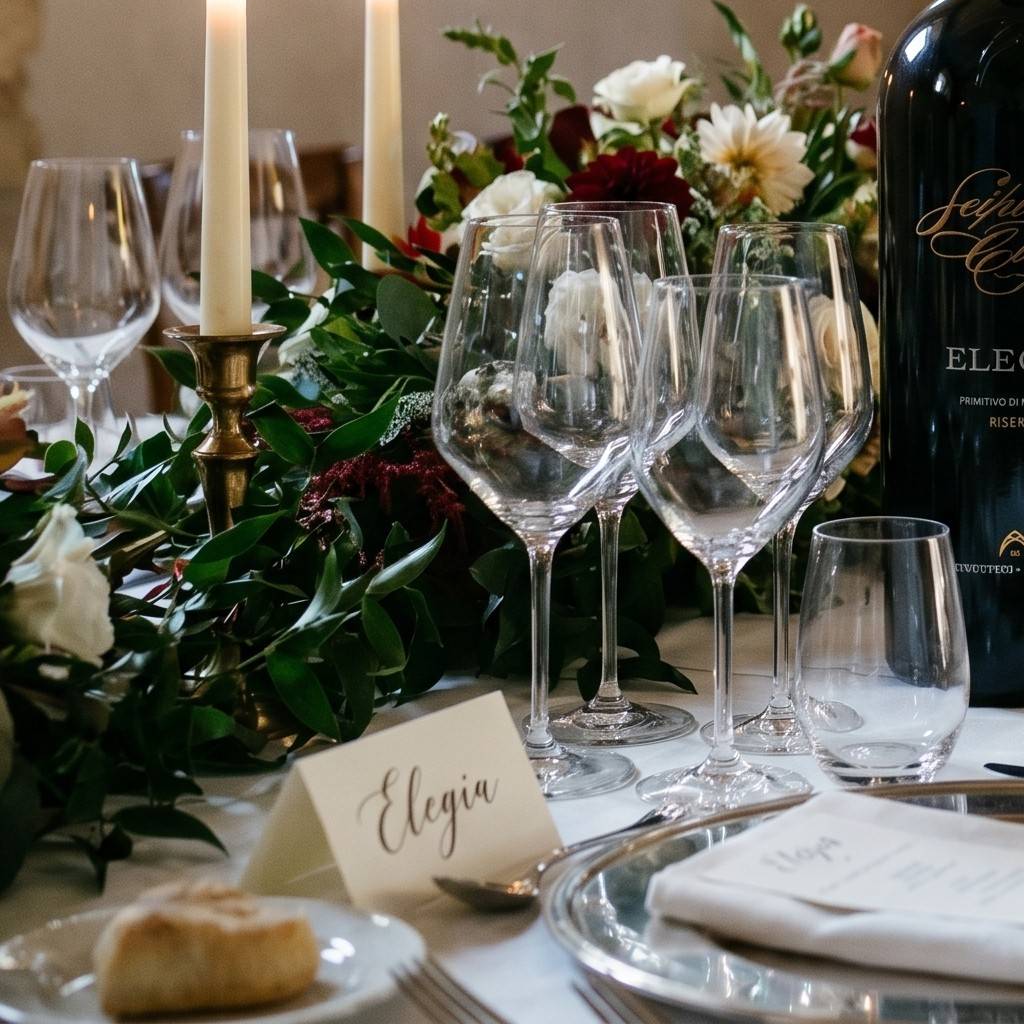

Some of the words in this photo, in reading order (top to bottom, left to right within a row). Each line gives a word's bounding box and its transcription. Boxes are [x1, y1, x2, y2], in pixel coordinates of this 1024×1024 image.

[959, 396, 1006, 407] PRIMITIVO
[1008, 396, 1019, 407] DI
[357, 764, 500, 860] Elegia
